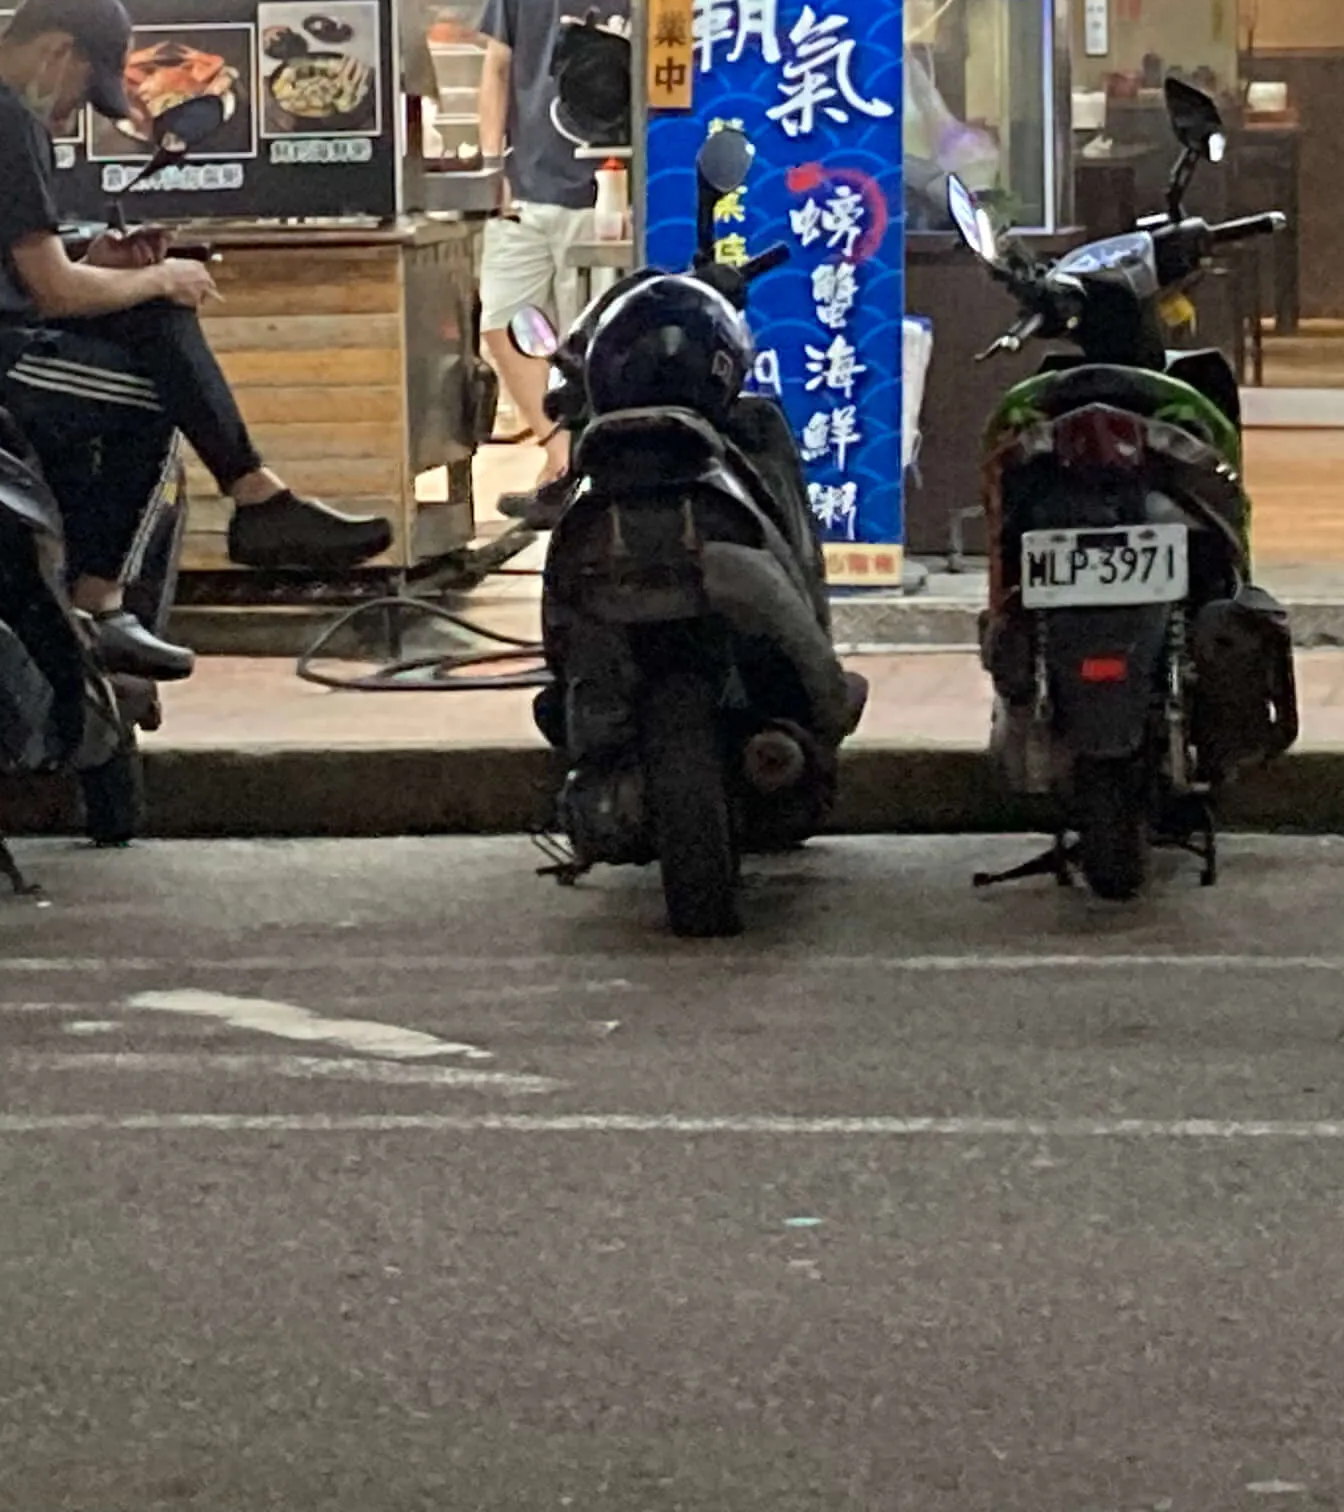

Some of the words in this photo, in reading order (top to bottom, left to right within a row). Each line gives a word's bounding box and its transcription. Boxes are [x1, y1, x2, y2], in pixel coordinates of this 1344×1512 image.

[789, 185, 866, 541] 螃蟹海鮮粥
[1027, 543, 1176, 588] MLP-3971
